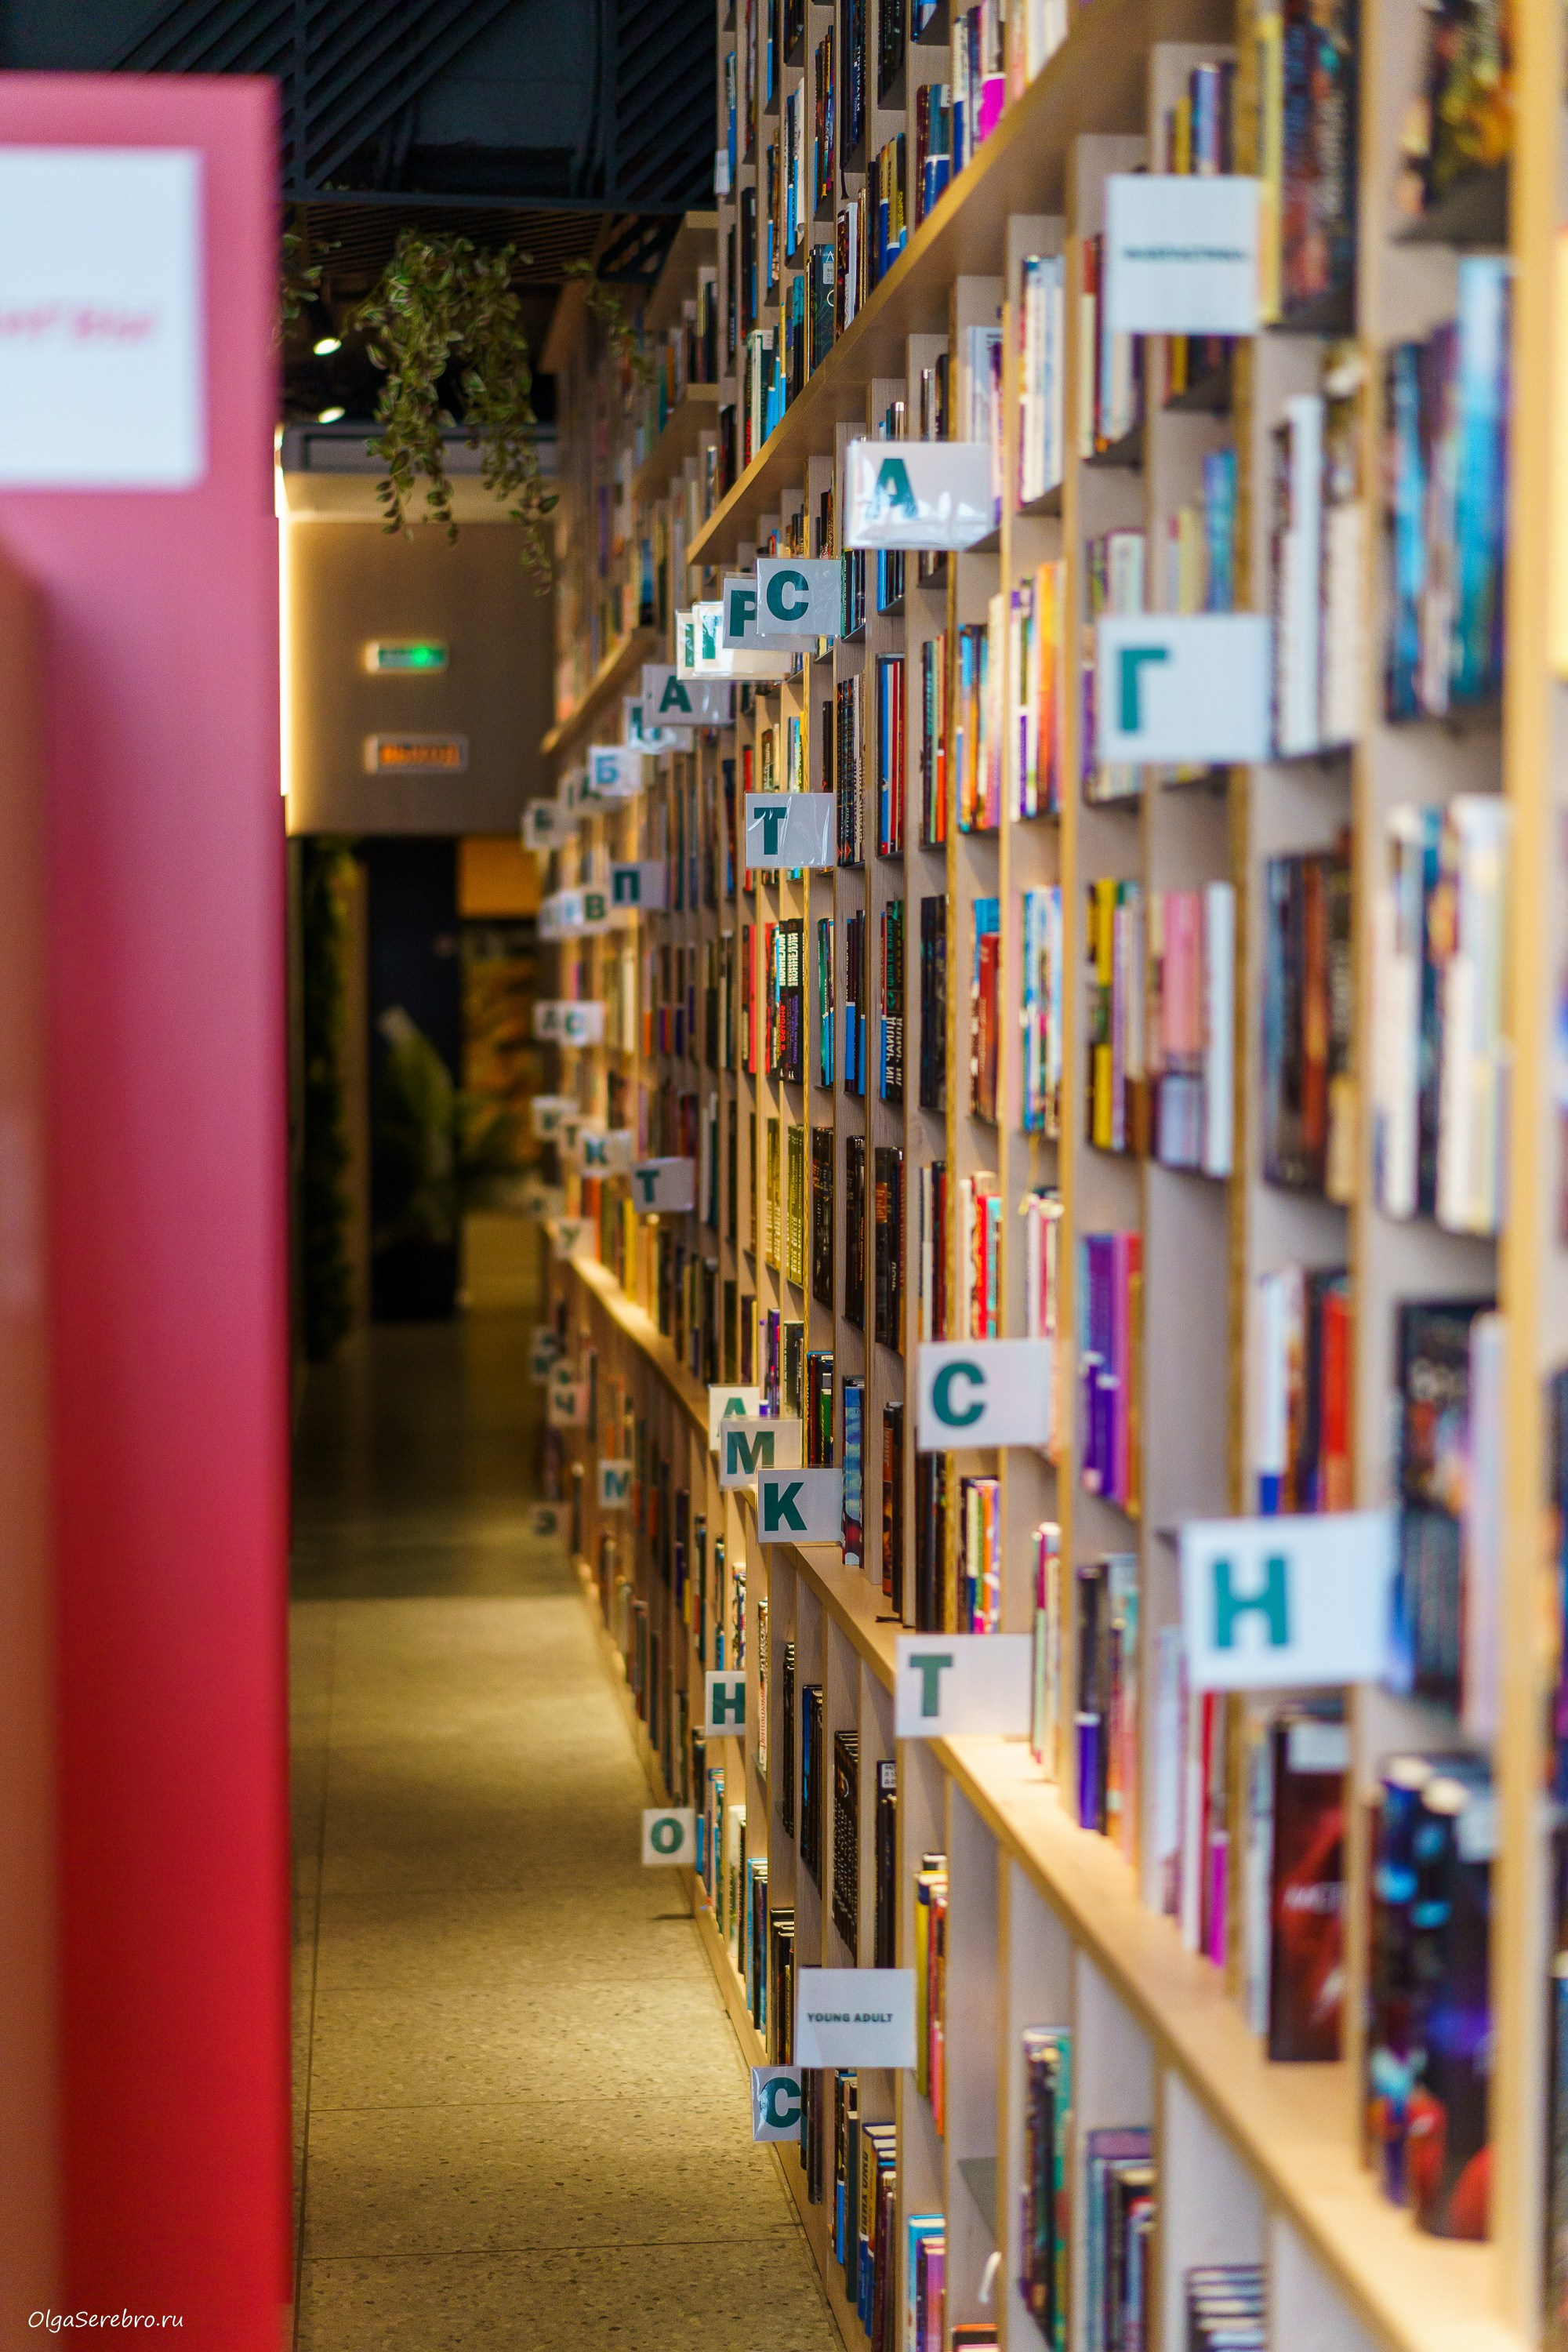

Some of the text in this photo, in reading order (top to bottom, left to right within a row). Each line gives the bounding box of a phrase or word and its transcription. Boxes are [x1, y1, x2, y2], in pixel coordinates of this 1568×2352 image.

[866, 459, 918, 519] А
[767, 570, 809, 621] С
[659, 676, 692, 713] А
[1119, 648, 1168, 733] Г
[595, 754, 619, 785] Б
[754, 808, 787, 855] Т
[584, 894, 606, 920] В
[614, 871, 641, 902] П
[564, 1011, 585, 1036] С
[636, 1170, 659, 1203] Т
[932, 1362, 985, 1427] С
[727, 1432, 775, 1474] М
[764, 1483, 808, 1531] К
[1213, 1555, 1290, 1650] Н
[712, 1682, 746, 1726] Н
[909, 1654, 953, 1717] Т
[651, 1817, 684, 1854] О
[808, 2012, 893, 2023] YOUNG ADULT
[758, 2077, 801, 2129] С
